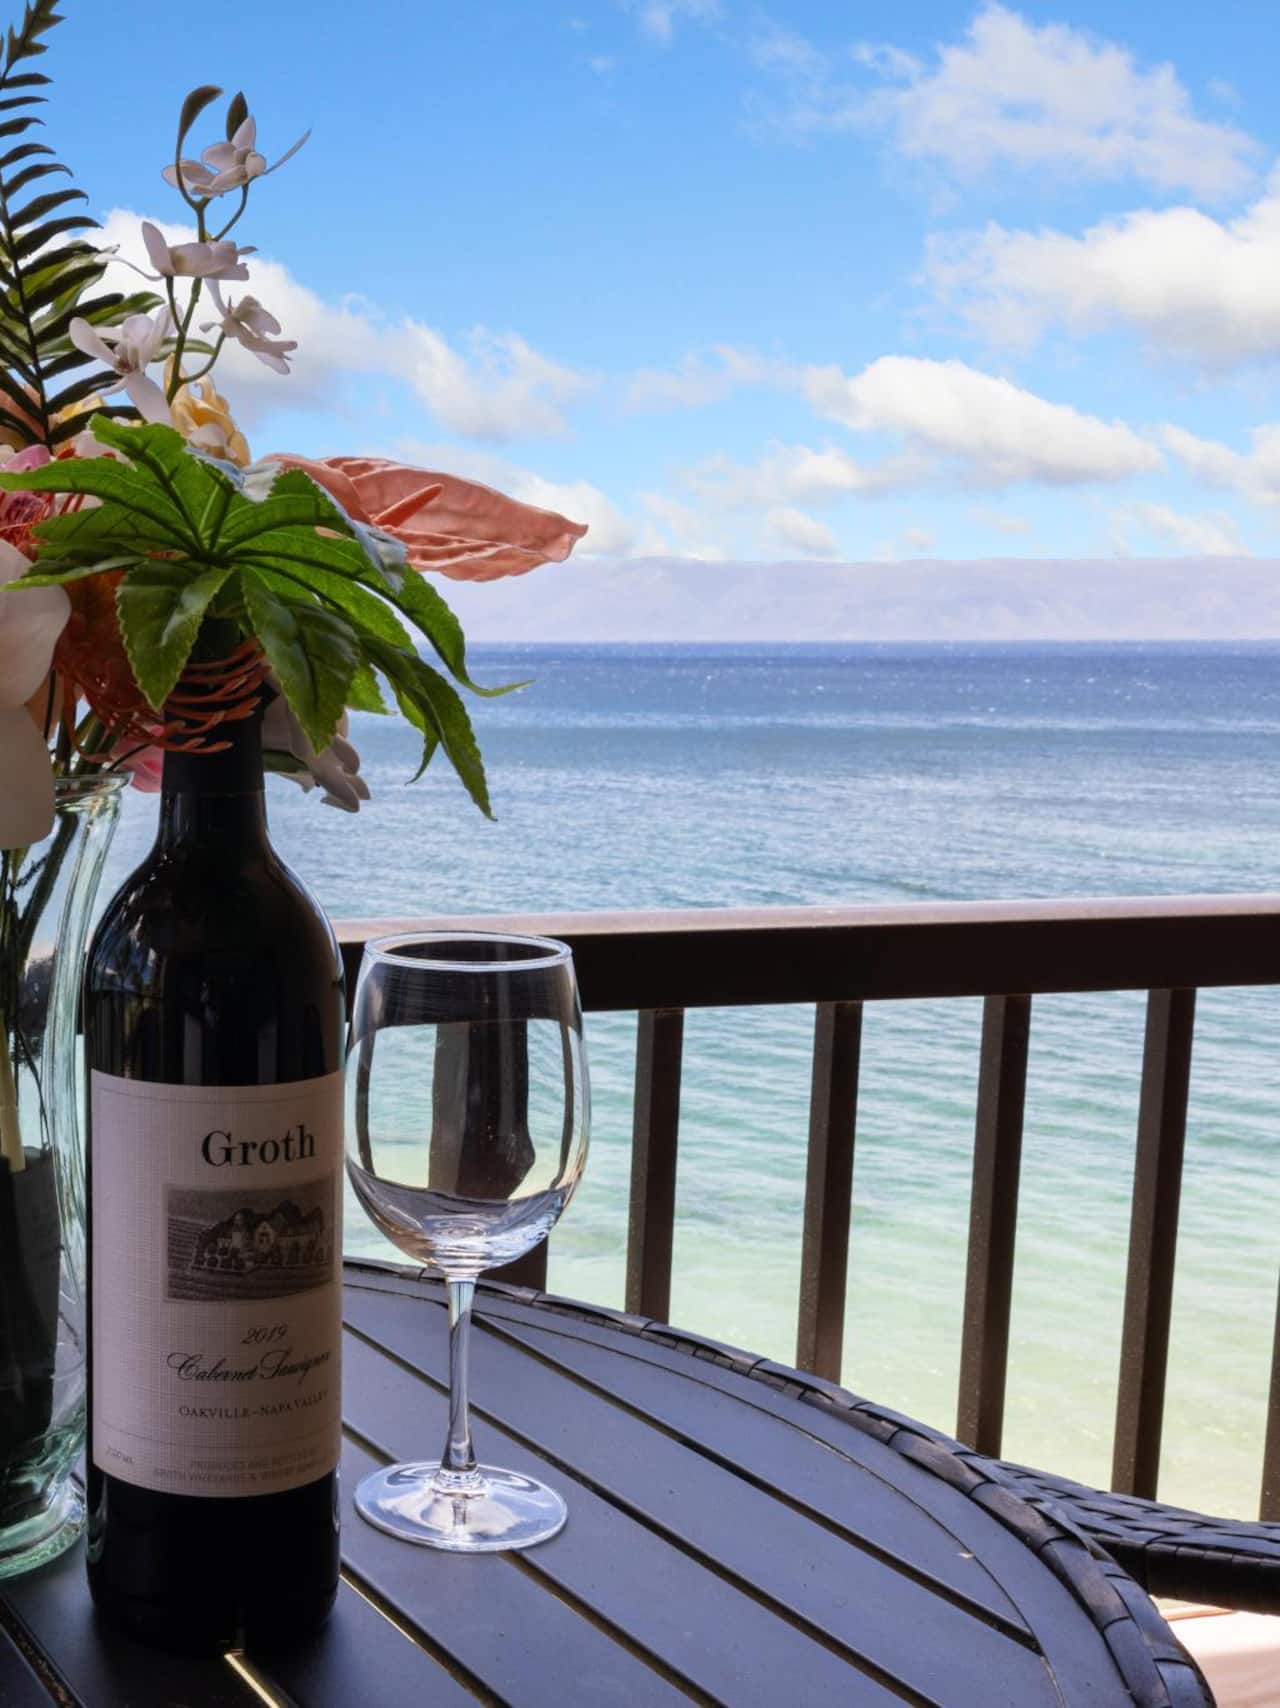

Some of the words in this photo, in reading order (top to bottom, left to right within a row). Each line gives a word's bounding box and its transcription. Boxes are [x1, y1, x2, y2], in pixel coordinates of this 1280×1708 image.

[201, 1125, 316, 1167] Groth
[240, 1324, 288, 1345] 2019
[167, 1352, 259, 1382] Cabernet
